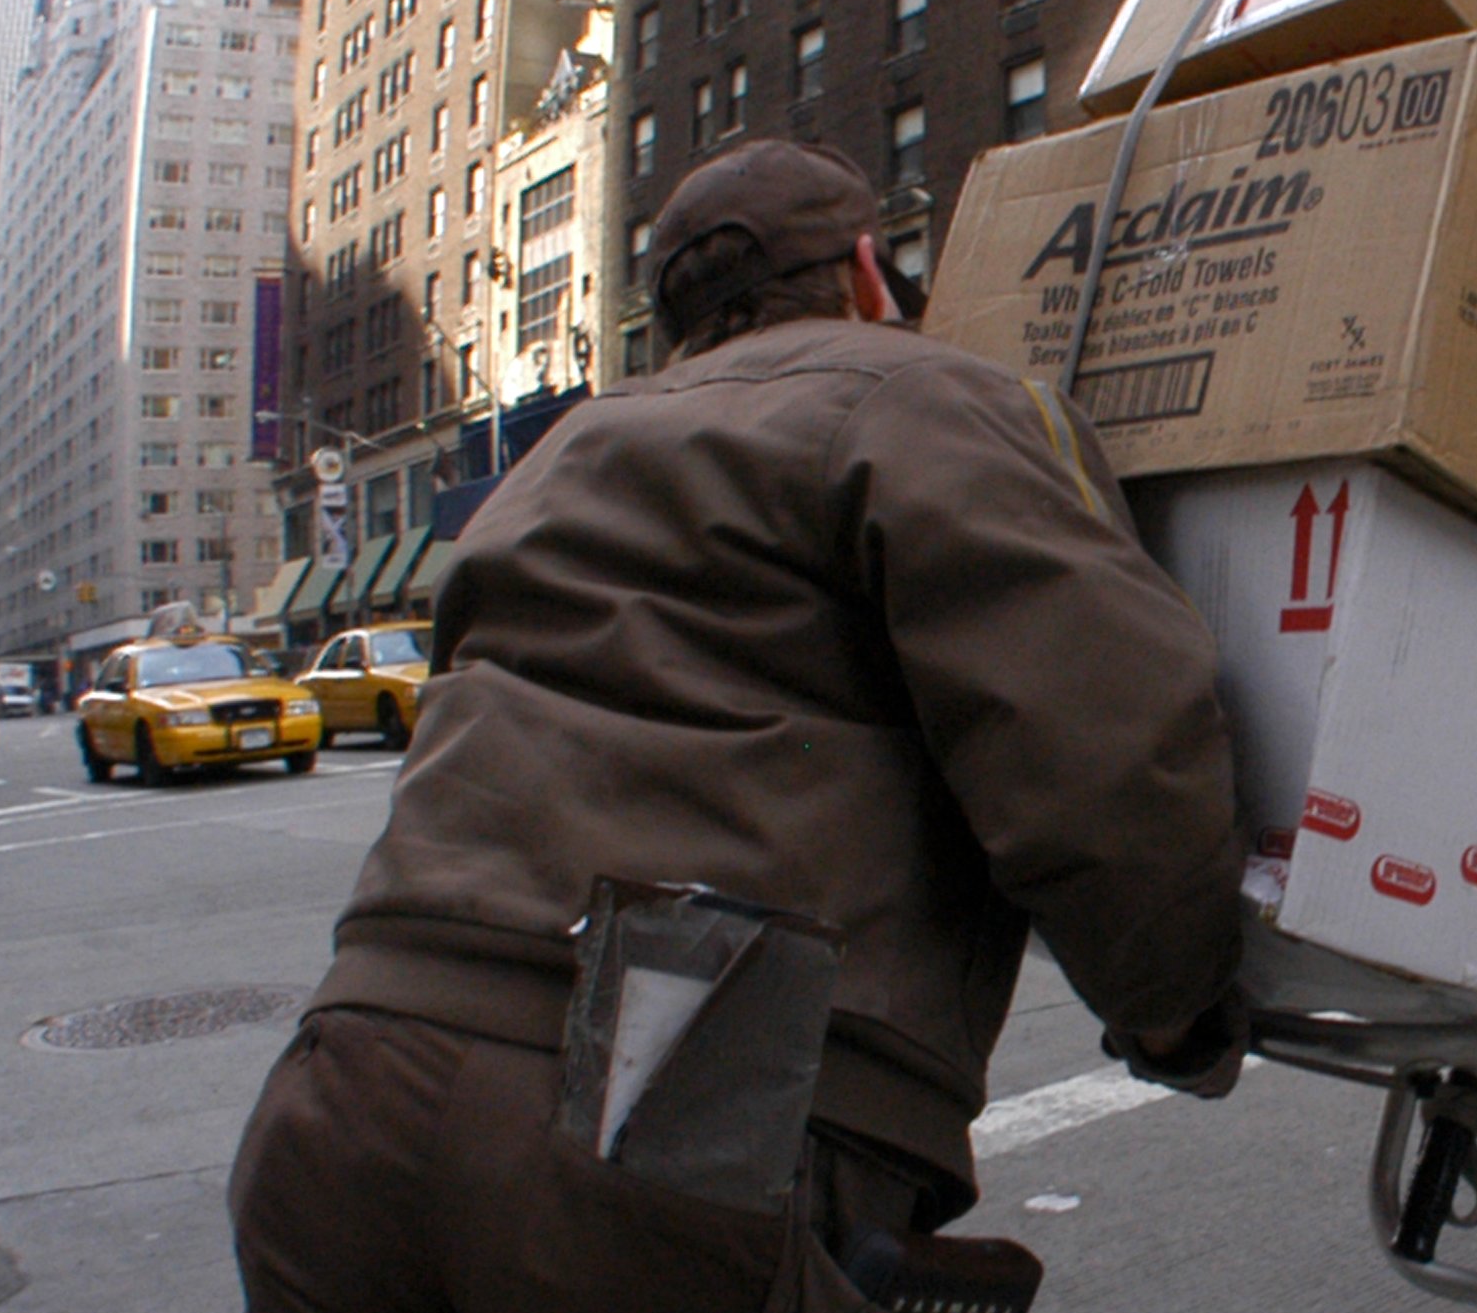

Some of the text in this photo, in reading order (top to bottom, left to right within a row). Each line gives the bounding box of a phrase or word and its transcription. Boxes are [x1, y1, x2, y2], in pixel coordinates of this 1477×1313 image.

[1255, 62, 1396, 160] 20603
[1040, 247, 1278, 317] Whe C-Fold Towels
[1212, 285, 1280, 313] blancas
[1106, 328, 1177, 358] blanches
[1219, 318, 1241, 339] en
[1244, 310, 1259, 334] C
